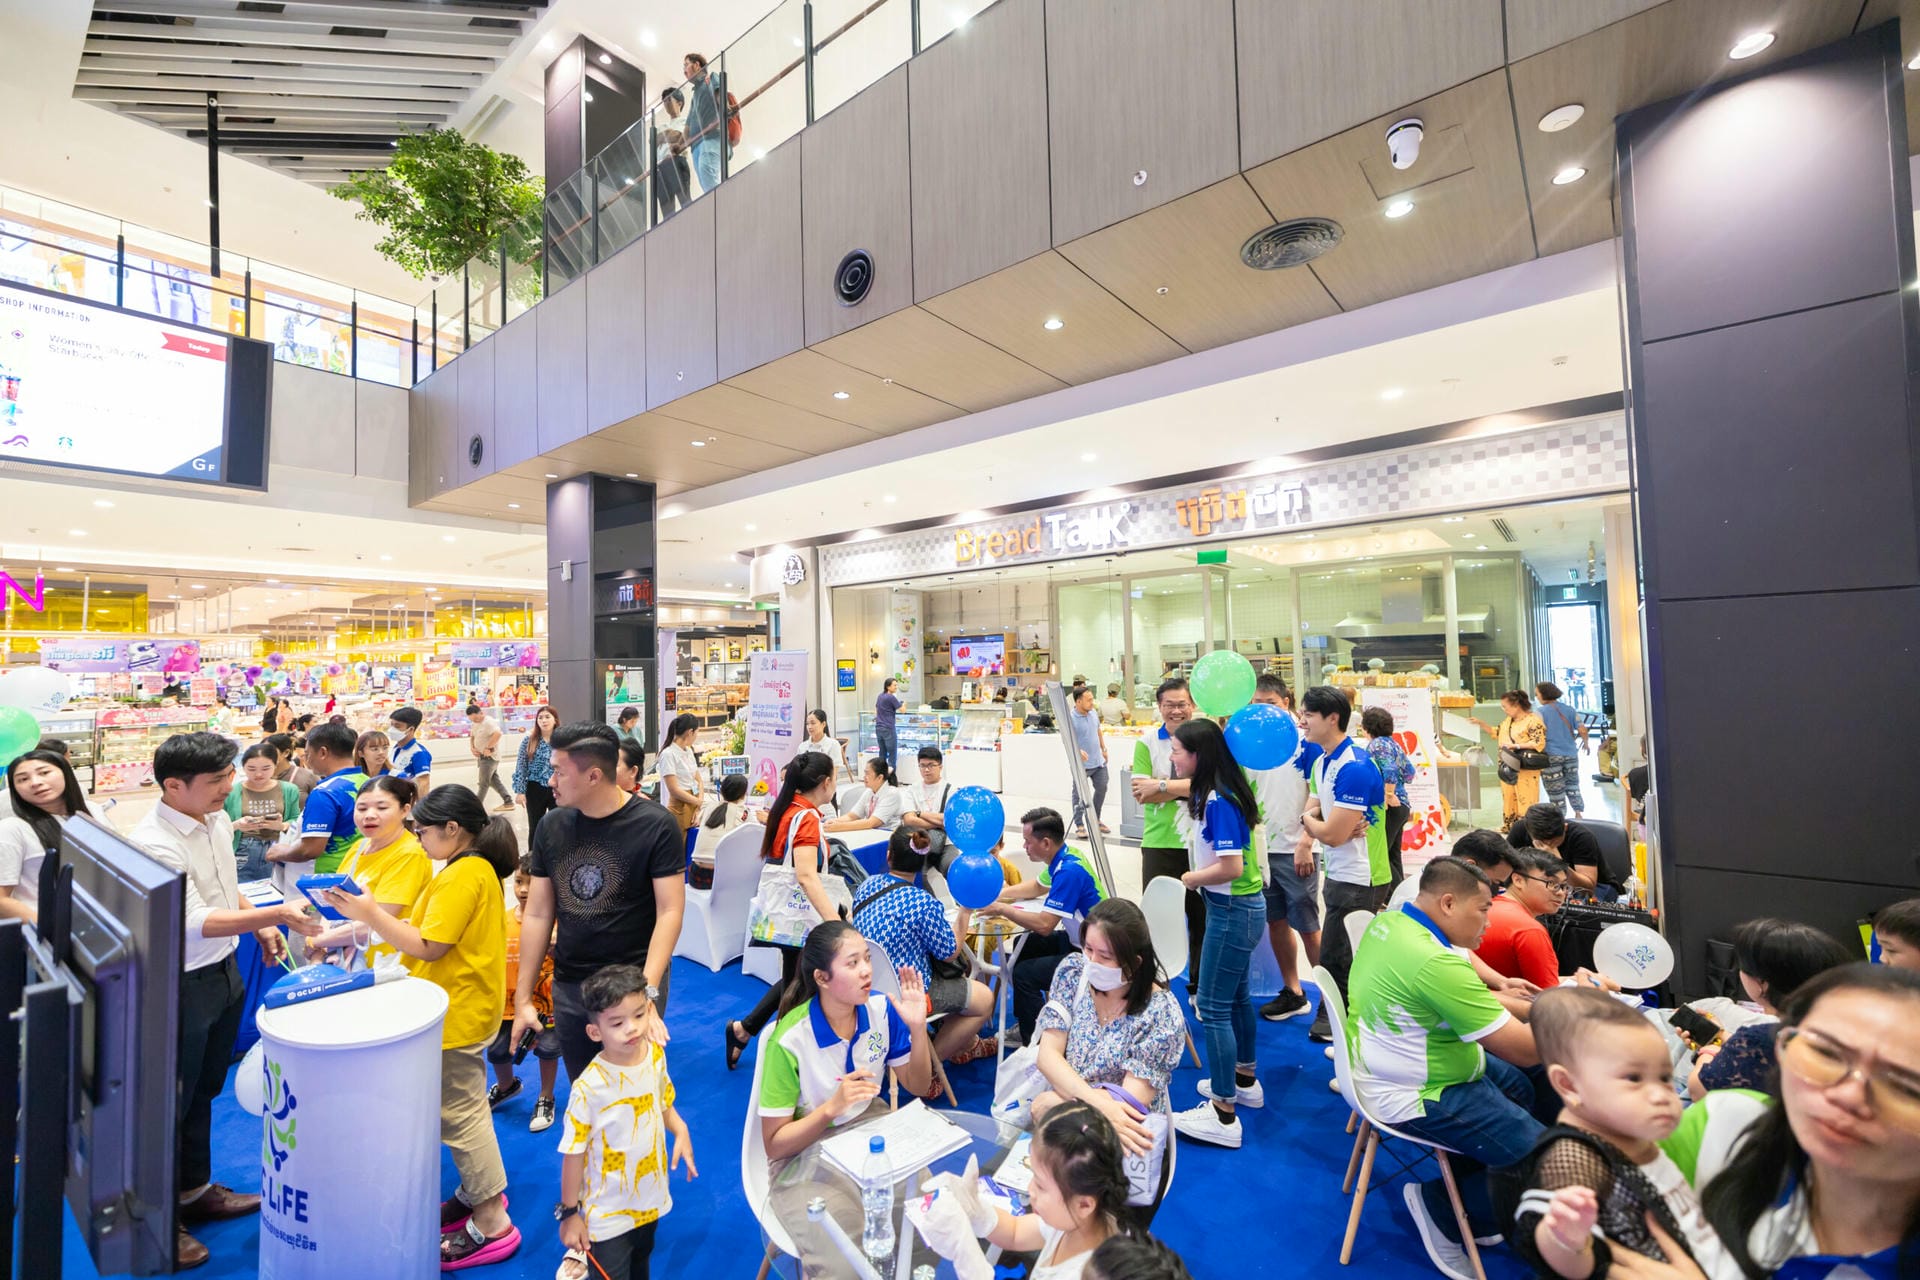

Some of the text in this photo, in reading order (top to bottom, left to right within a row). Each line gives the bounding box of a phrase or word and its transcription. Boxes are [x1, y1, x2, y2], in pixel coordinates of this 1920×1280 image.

[0, 296, 91, 322] SHOP INFORMATION
[187, 342, 211, 353] Today
[366, 653, 401, 663] EVENT
[296, 989, 308, 997] GC
[869, 1054, 878, 1063] GC
